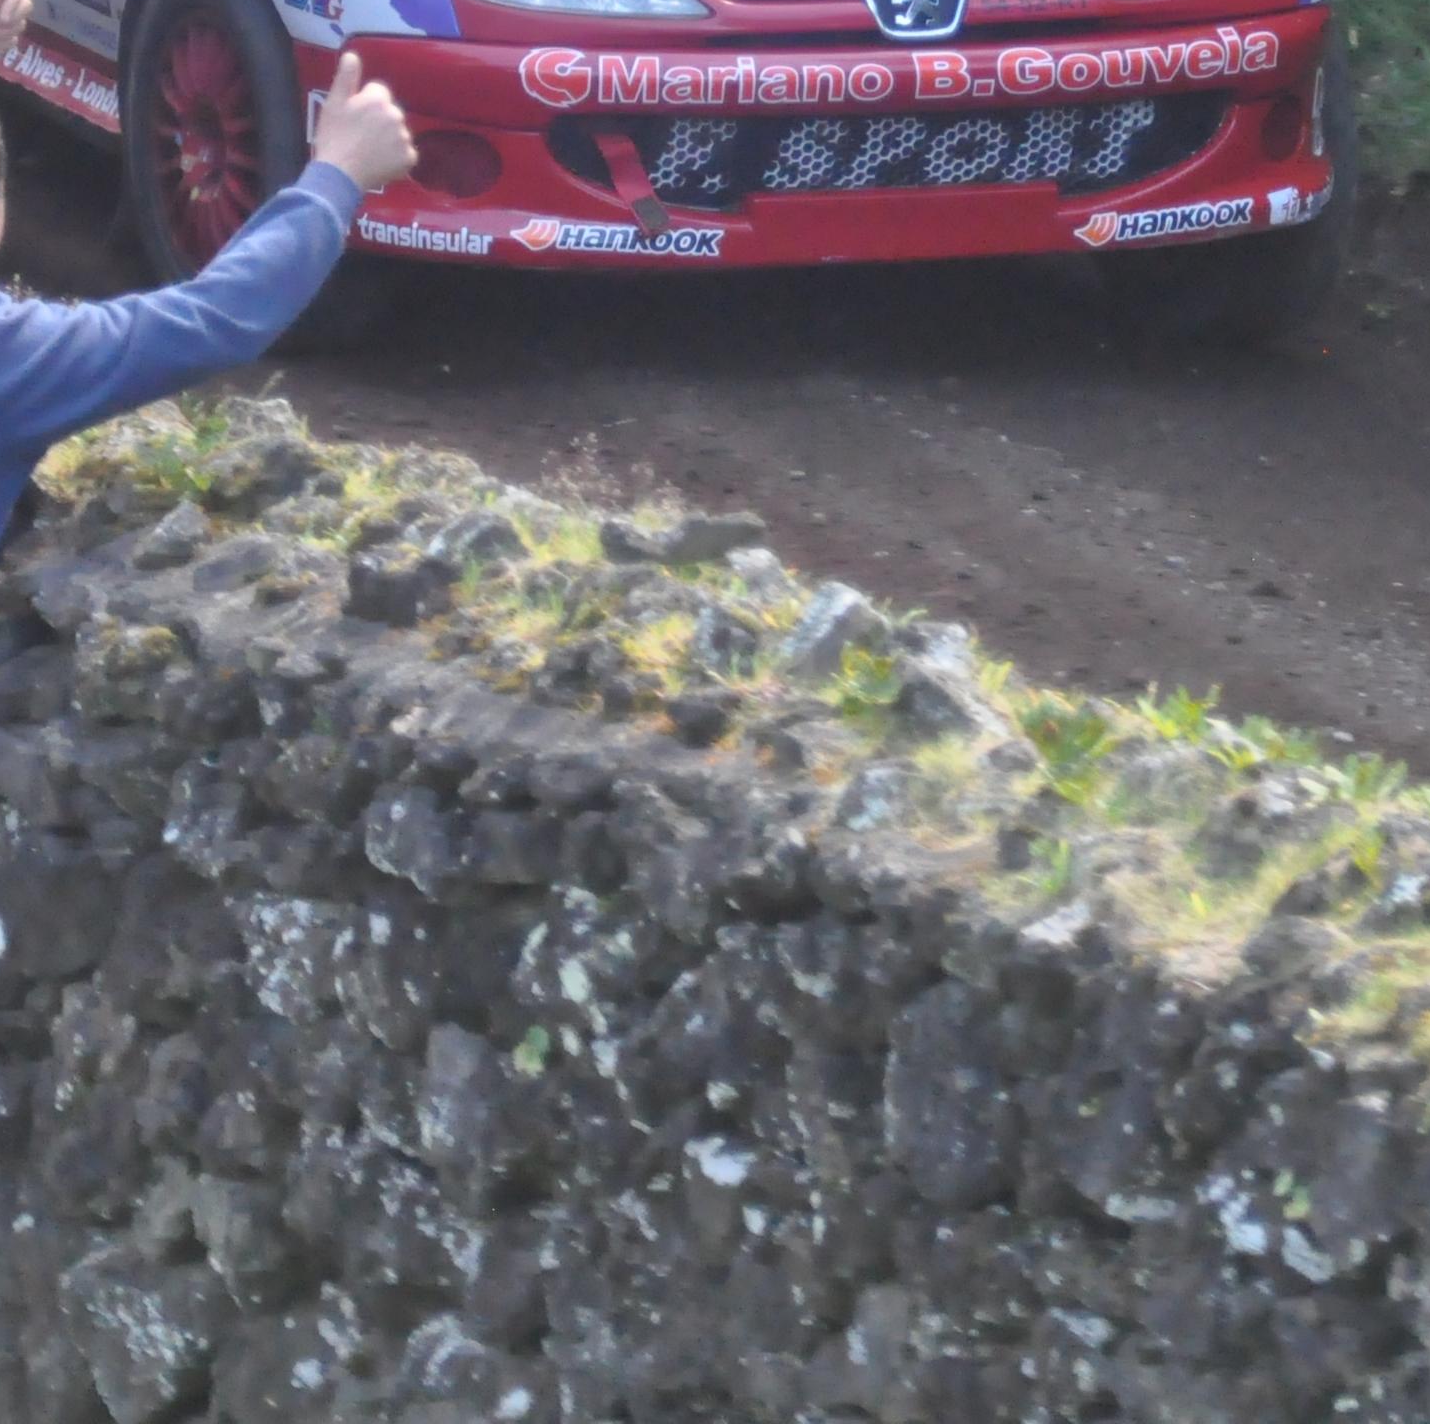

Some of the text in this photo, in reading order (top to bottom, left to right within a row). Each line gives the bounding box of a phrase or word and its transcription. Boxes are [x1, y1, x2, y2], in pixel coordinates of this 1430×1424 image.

[16, 45, 65, 89] Alves
[597, 50, 894, 106] Mariano
[761, 97, 1156, 192] SPORT
[356, 212, 494, 256] transinsular
